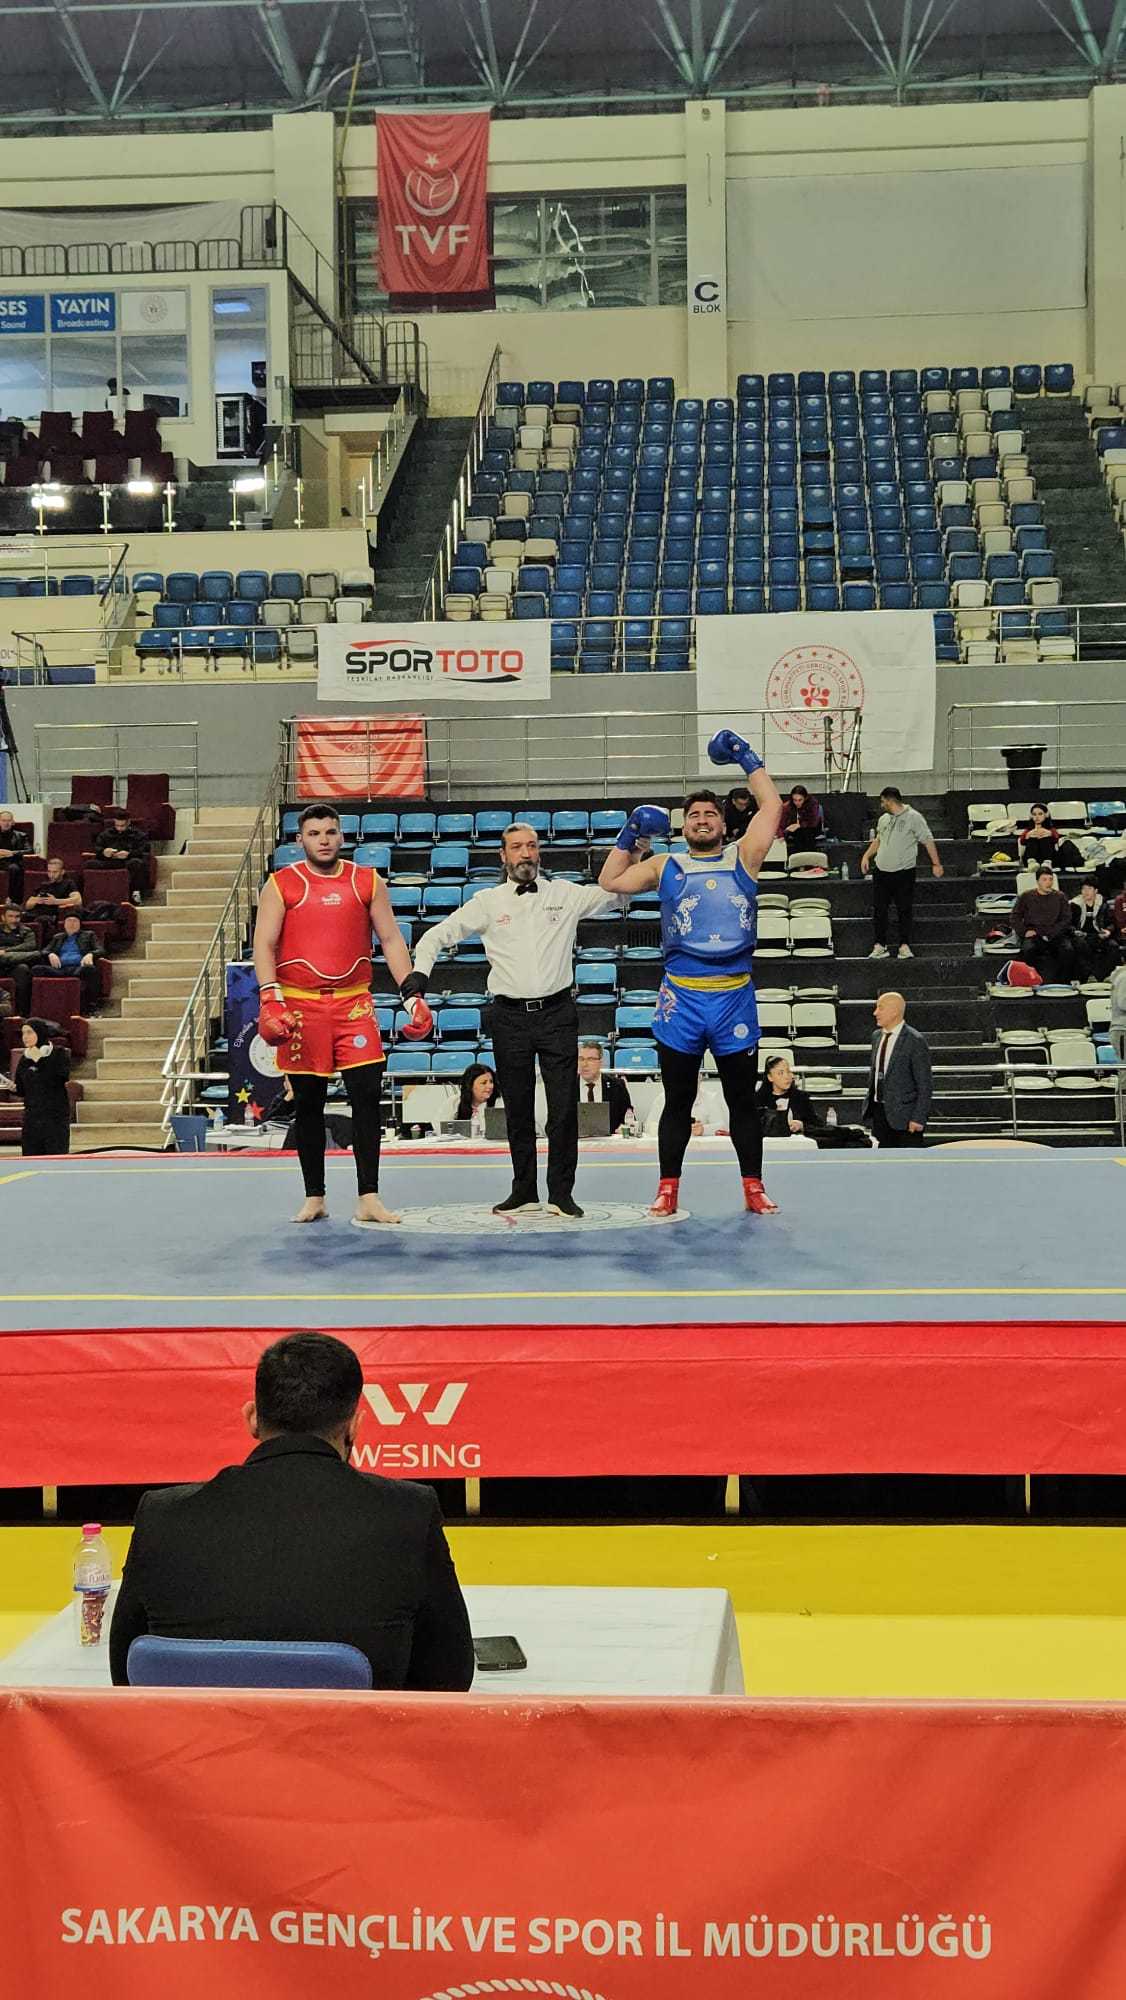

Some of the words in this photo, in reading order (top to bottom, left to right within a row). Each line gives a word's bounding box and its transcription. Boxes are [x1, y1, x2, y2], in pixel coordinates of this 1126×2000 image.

[395, 225, 470, 255] TVF
[694, 281, 719, 302] C
[0, 301, 27, 316] SES
[57, 298, 109, 314] YAYIN
[693, 304, 721, 313] BLOK
[1, 321, 26, 329] Sound
[57, 319, 109, 328] Broadcasting
[351, 1444, 481, 1467] WESING
[61, 1906, 259, 1944] SAKARYA
[270, 1907, 453, 1959] GENÇLİK
[462, 1917, 516, 1953] VE
[528, 1917, 643, 1956] SPOR
[656, 1913, 691, 1957] İL
[704, 1914, 991, 1959] MÜDÜRLÜĞÜ
